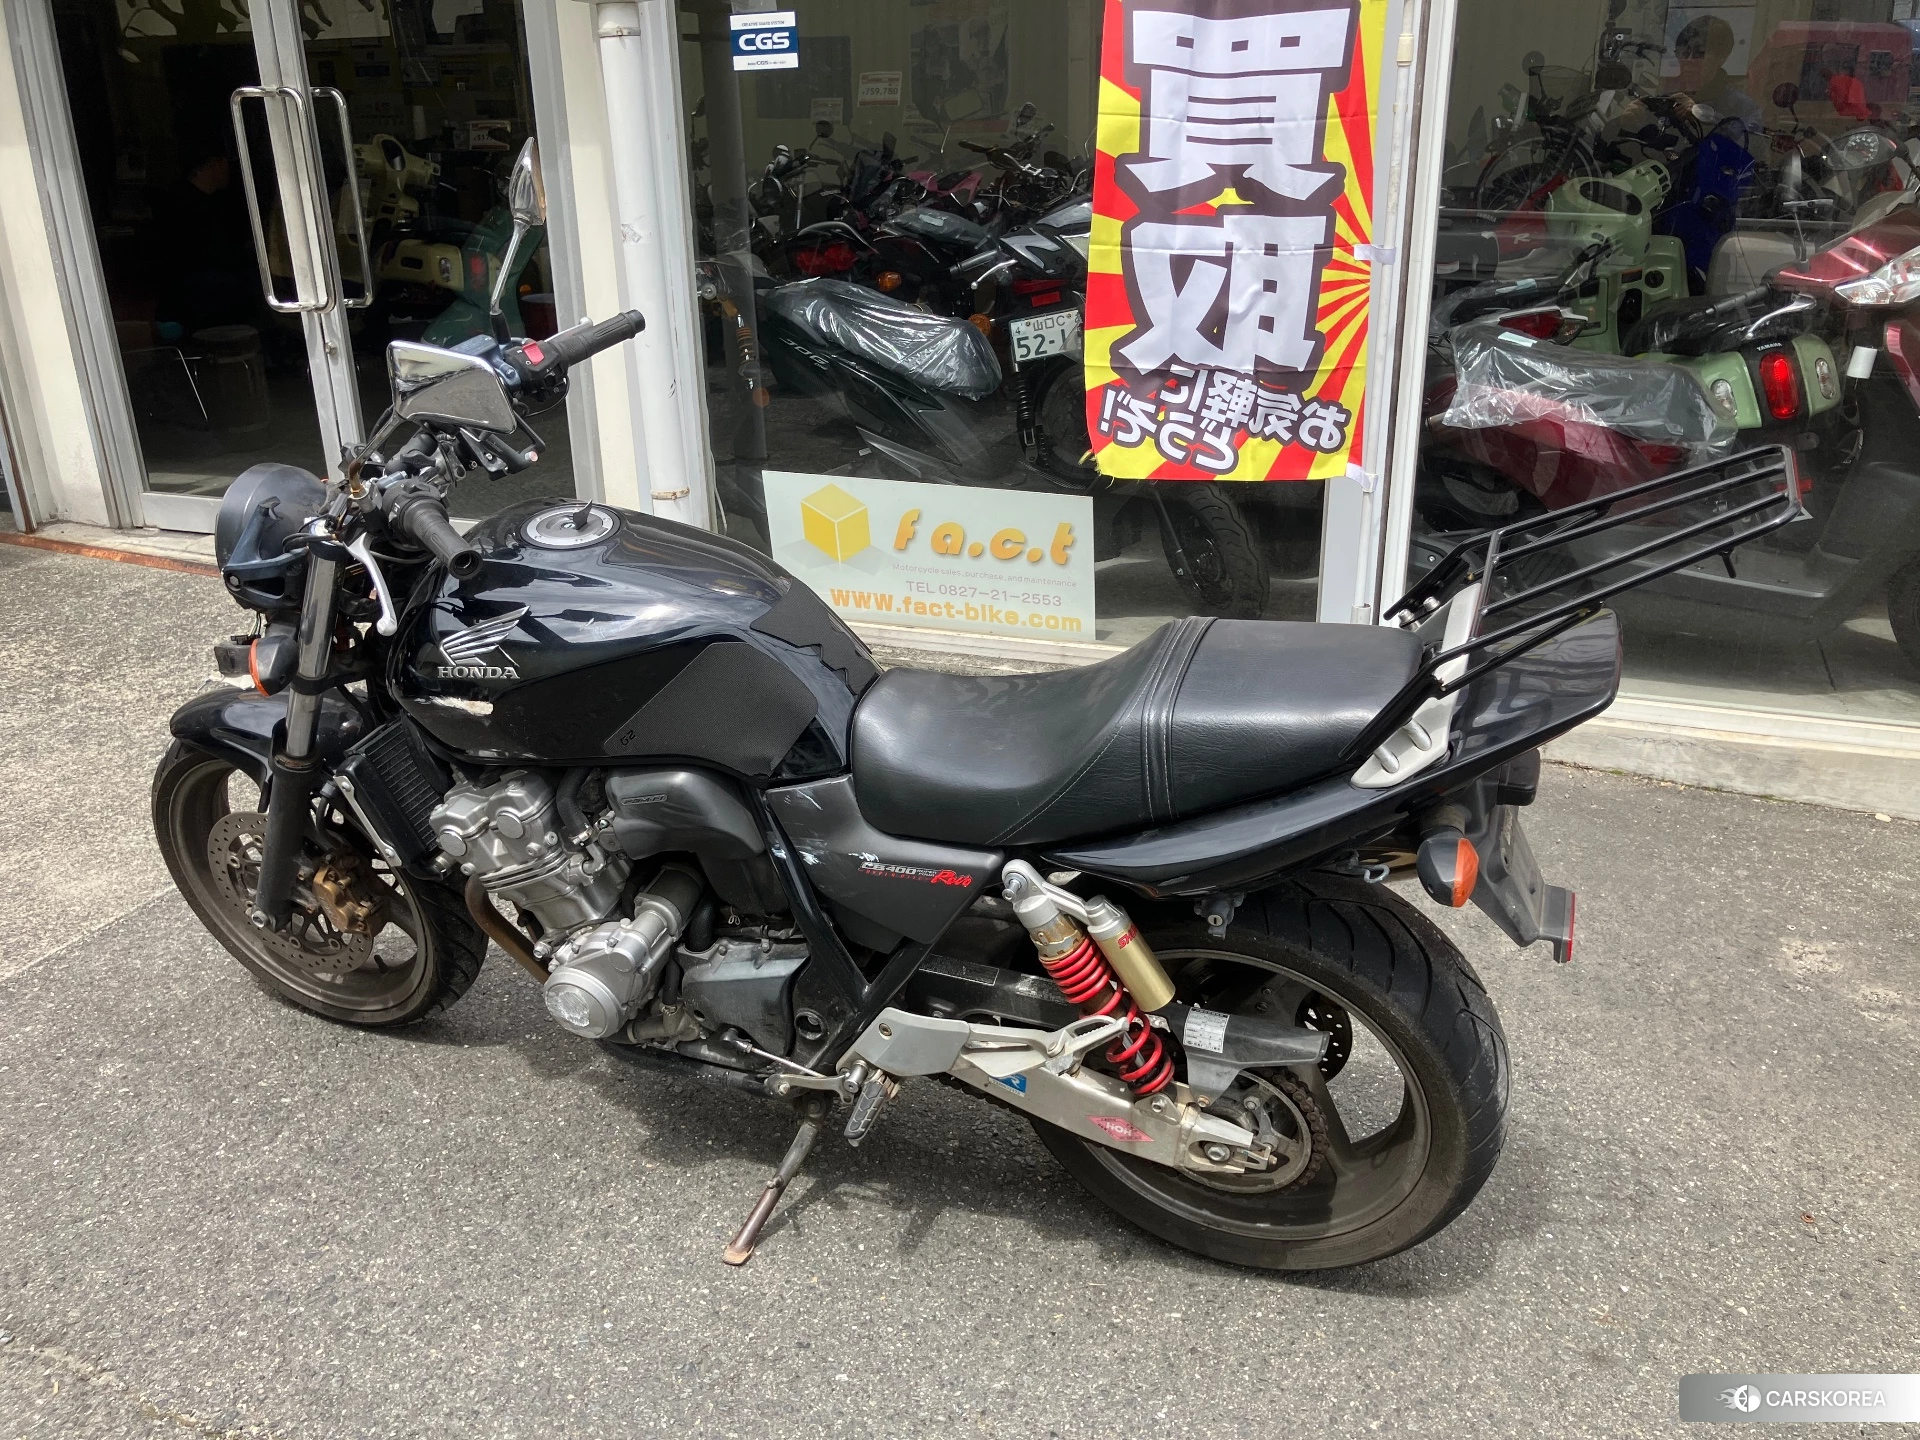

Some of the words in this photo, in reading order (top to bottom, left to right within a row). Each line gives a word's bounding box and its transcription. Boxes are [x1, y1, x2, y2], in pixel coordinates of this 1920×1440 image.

[738, 31, 790, 50] CGS
[1016, 328, 1066, 359] 52-1
[892, 563, 940, 575] Motorcycle
[1024, 576, 1077, 588] maintenance
[905, 580, 935, 594] TEL
[938, 584, 1062, 607] 0827-21-2553
[830, 588, 1082, 632] www.fact-bike.com
[437, 666, 520, 679] HONDA
